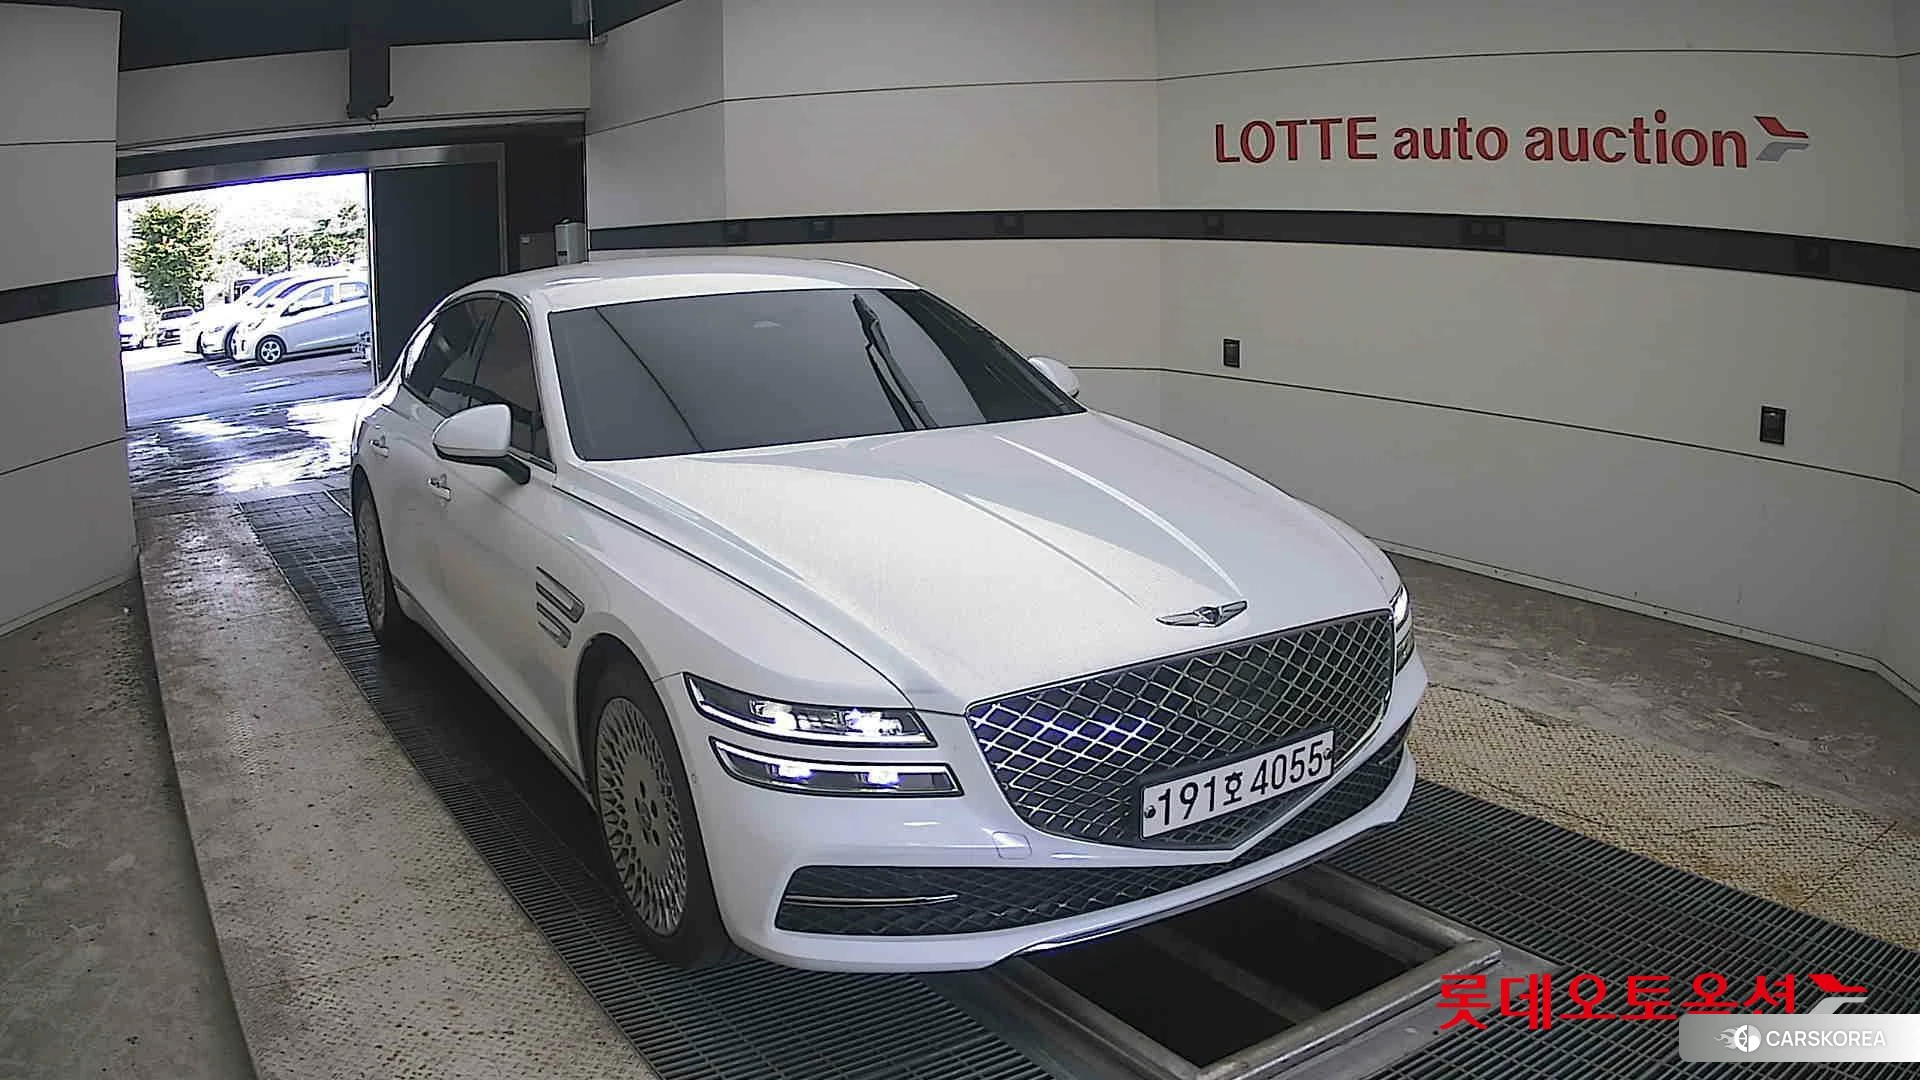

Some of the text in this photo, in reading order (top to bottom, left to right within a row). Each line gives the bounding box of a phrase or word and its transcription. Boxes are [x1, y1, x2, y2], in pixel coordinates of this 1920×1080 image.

[1215, 109, 1748, 168] LOTTE auto auction
[1250, 740, 1323, 795] 4055
